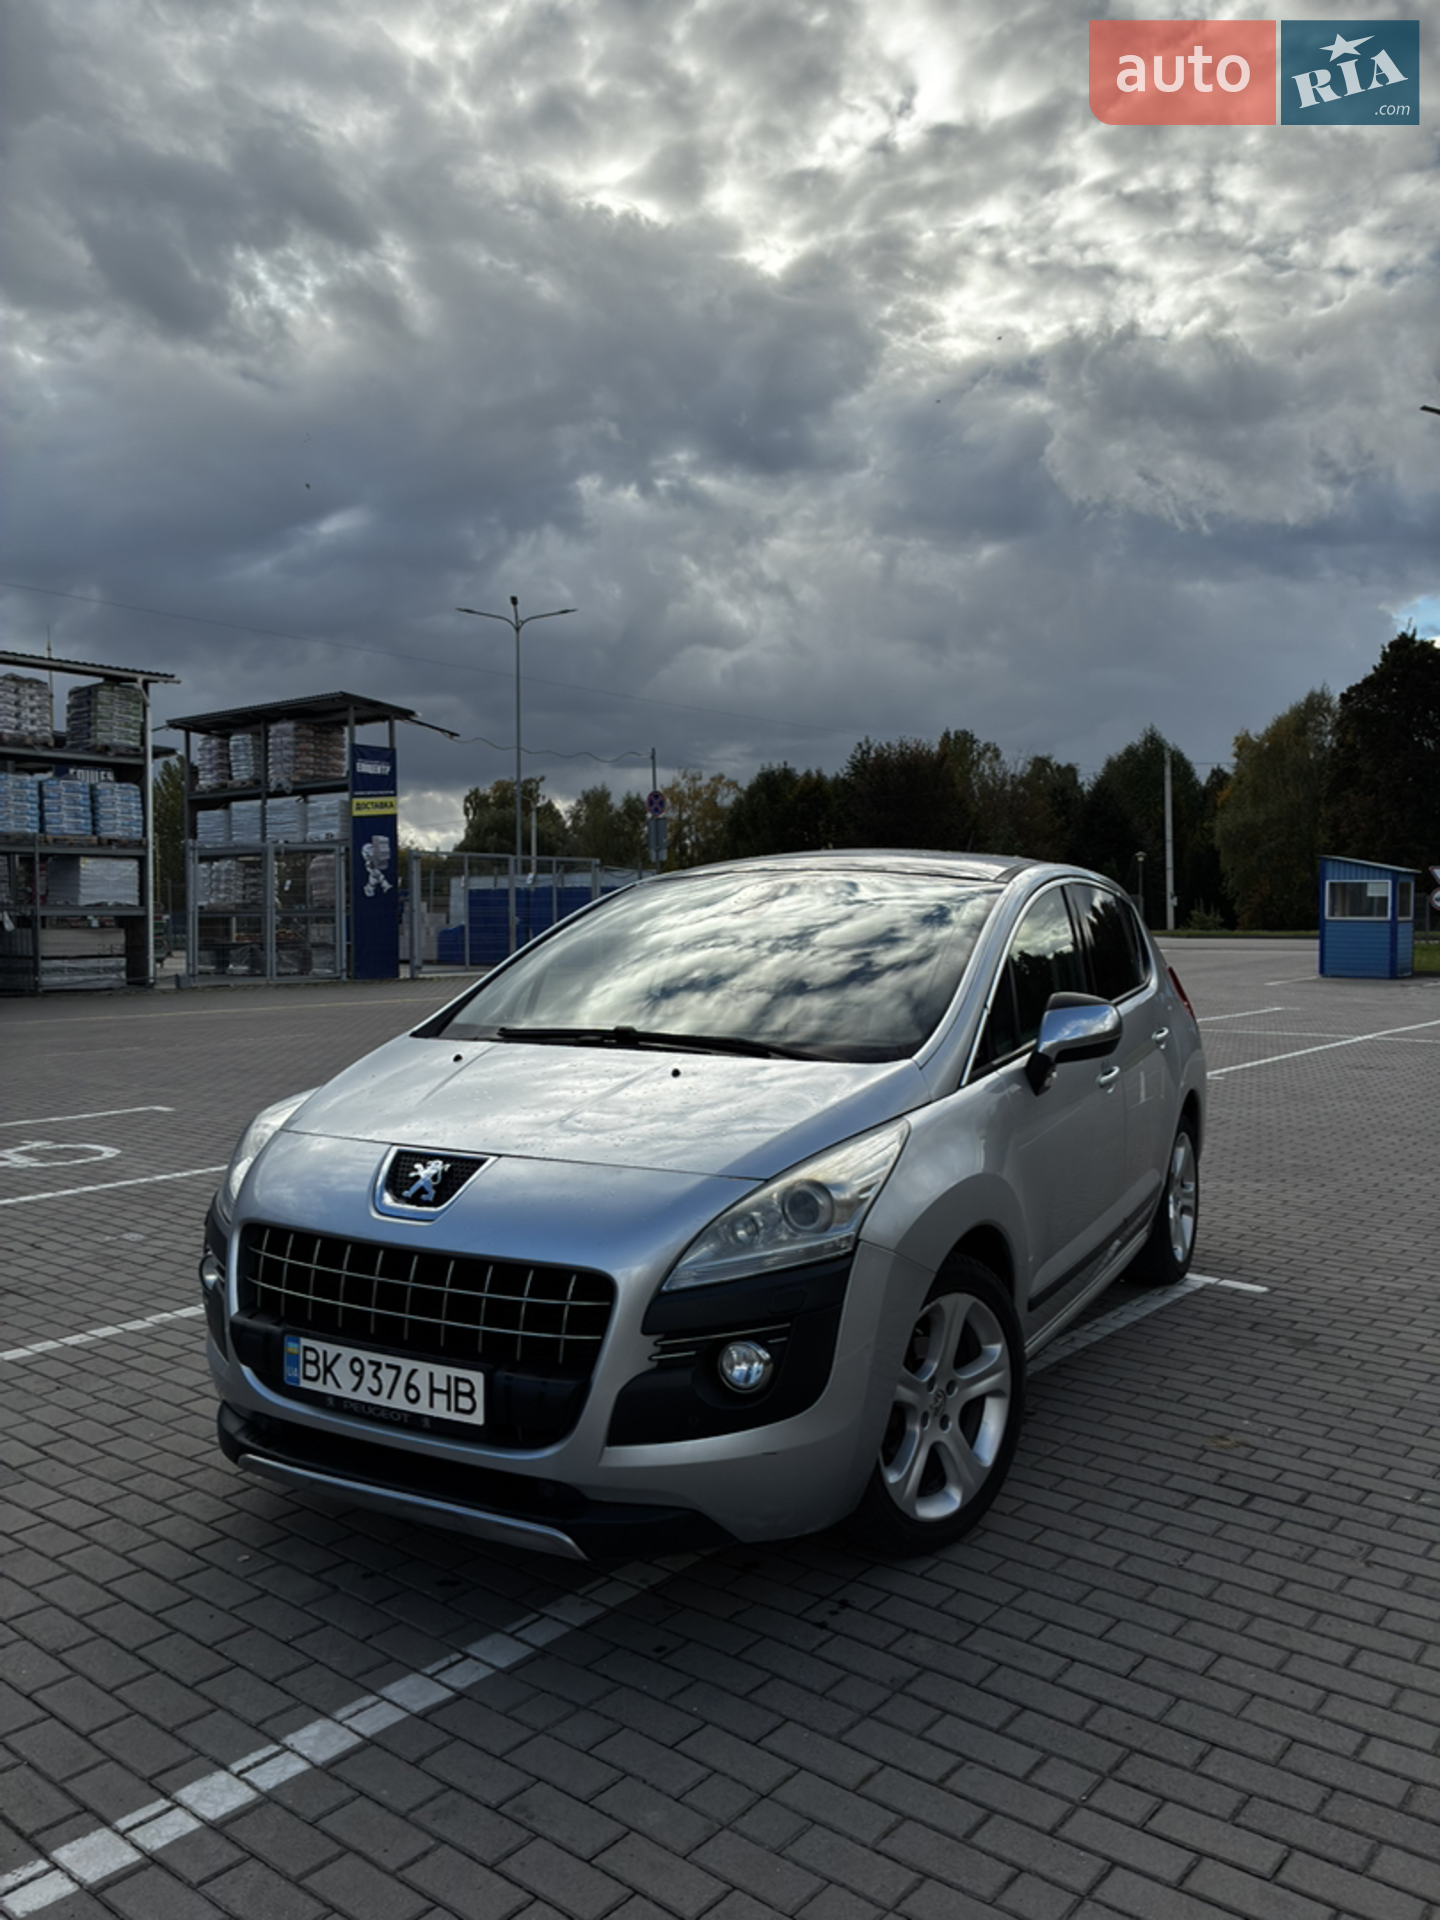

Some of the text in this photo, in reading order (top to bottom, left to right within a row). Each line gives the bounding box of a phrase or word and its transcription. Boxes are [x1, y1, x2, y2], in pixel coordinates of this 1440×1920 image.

[355, 800, 394, 811] ДОСТАВКА
[302, 1345, 477, 1415] BK 9376 HB
[342, 1400, 411, 1424] PEUGEOT
